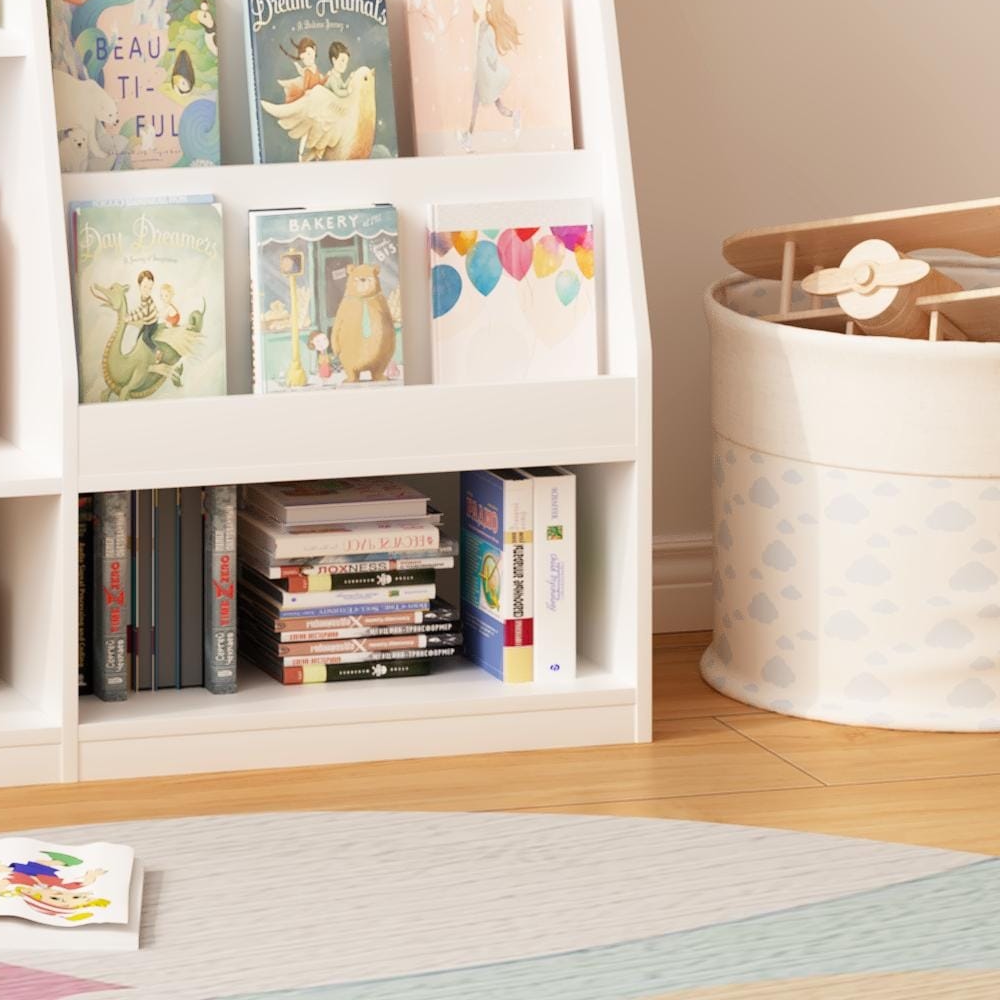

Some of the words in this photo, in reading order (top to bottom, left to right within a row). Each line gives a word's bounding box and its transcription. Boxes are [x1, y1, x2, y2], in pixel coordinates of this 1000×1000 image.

[95, 34, 177, 62] BEAU-
[117, 76, 154, 99] TI-
[135, 114, 180, 138] FUL
[79, 222, 122, 262] Day
[131, 212, 217, 259] Dreamers
[289, 215, 358, 233] BAKERY
[110, 560, 120, 589] ZERO
[220, 555, 230, 583] ZERO
